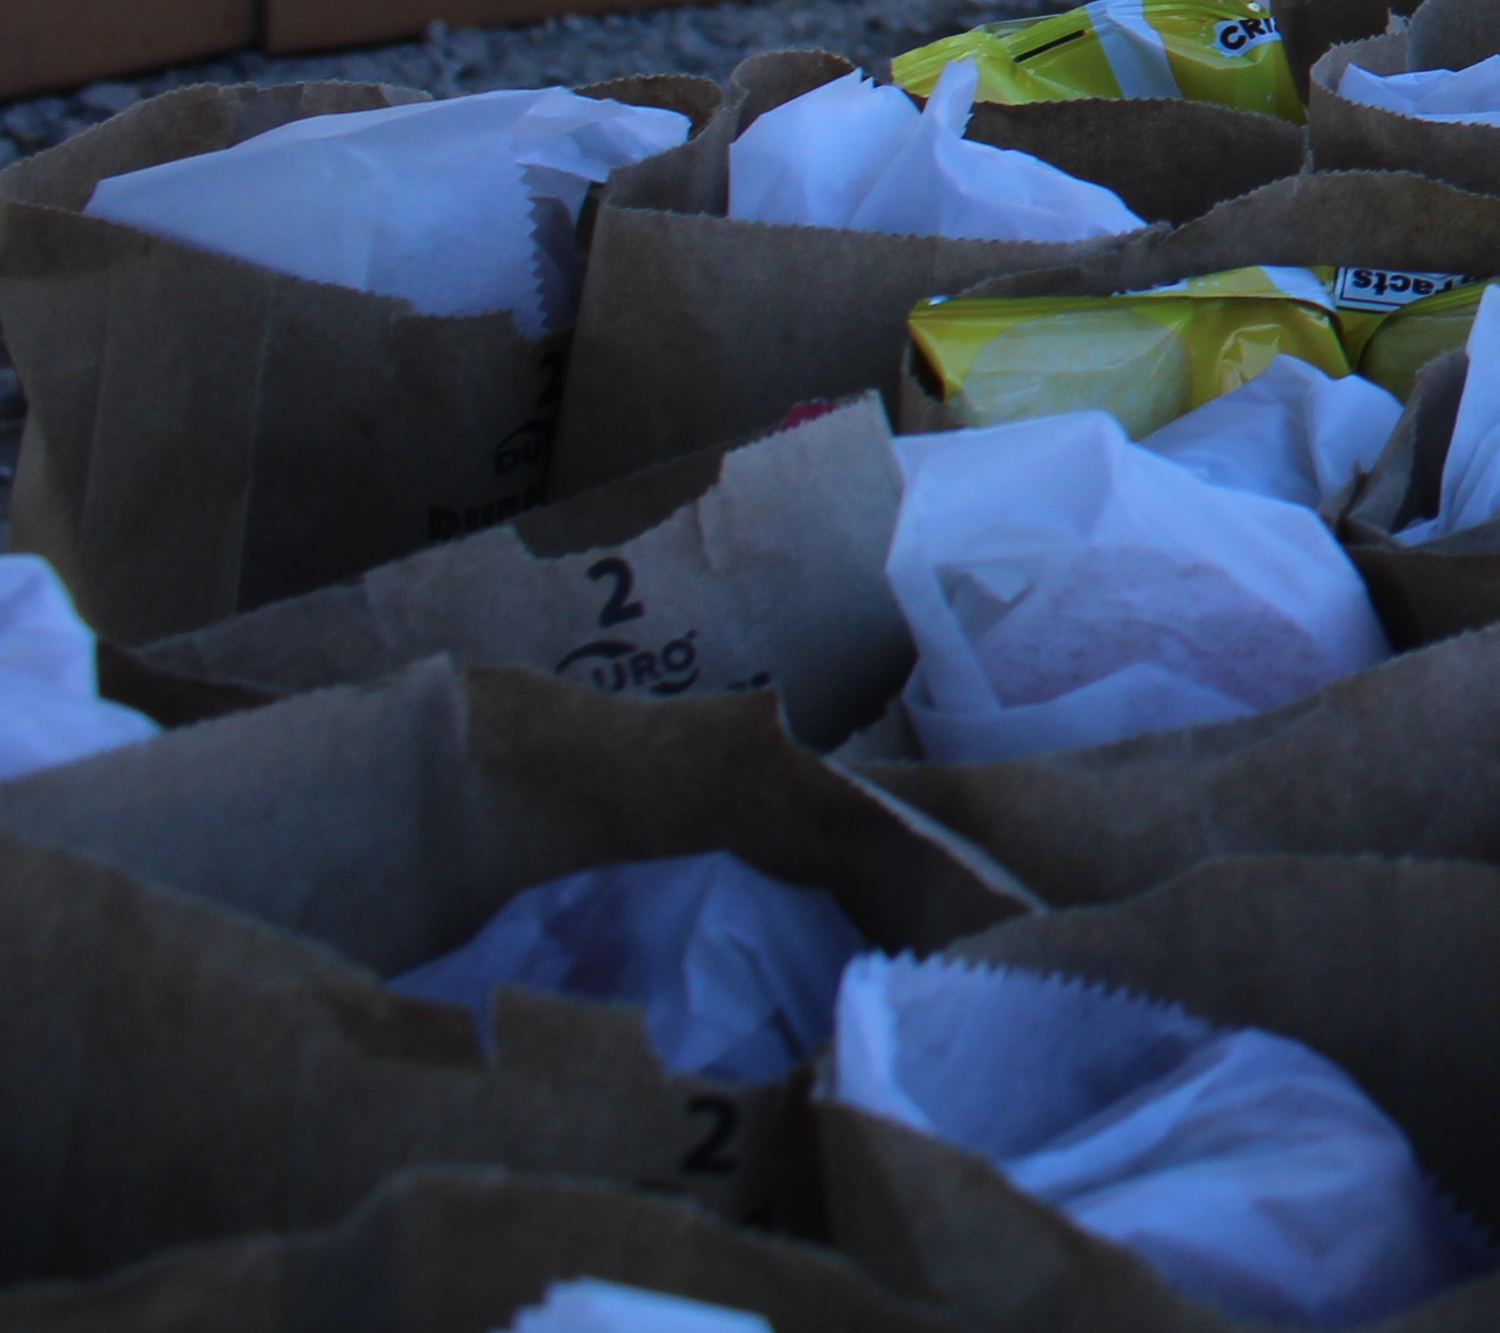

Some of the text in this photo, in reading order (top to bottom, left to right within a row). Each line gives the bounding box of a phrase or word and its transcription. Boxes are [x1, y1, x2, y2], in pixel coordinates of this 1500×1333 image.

[1219, 18, 1279, 50] CRI
[587, 556, 646, 628] 2
[683, 1093, 739, 1173] 2
